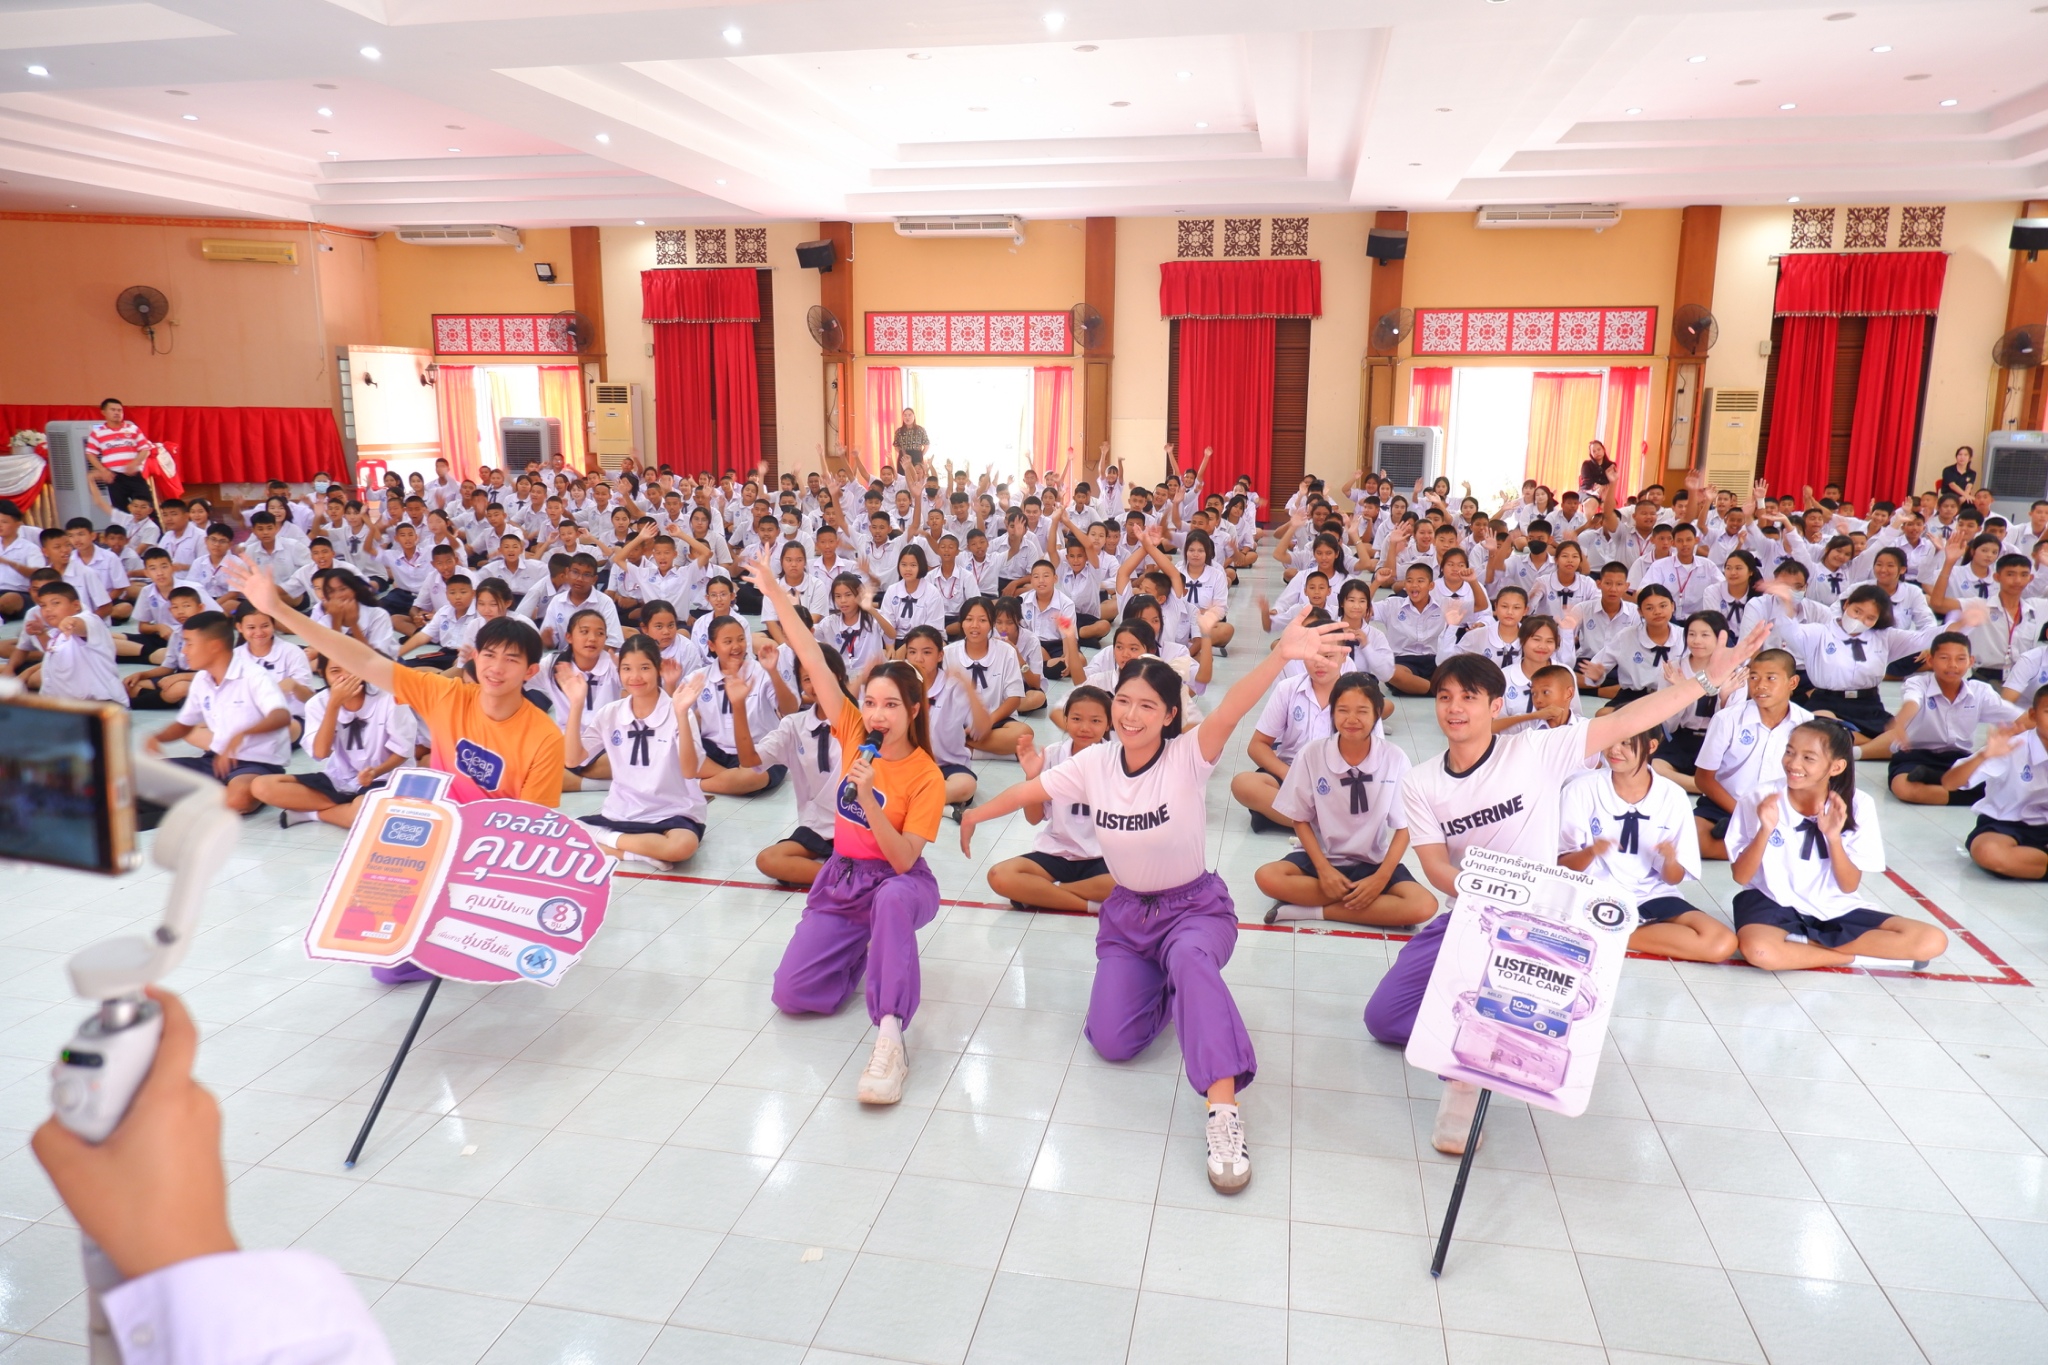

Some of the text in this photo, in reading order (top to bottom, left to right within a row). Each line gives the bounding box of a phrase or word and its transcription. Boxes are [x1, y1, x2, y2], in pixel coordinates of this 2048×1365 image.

[461, 748, 495, 771] Clean
[461, 760, 491, 782] lear
[484, 811, 570, 838] เจลส้ม
[1096, 803, 1170, 831] LISTERINE
[1441, 794, 1524, 837] LISTERINE
[388, 830, 417, 842] Clear
[391, 821, 424, 833] Clean
[370, 851, 426, 871] foaming
[462, 836, 618, 886] คุมมัน
[1465, 860, 1537, 883] ปากสะอาดขึ้น
[1469, 847, 1594, 886] บ้วนทุกครั้งหลังแปรงฟัน
[1470, 878, 1517, 900] 5 เท่า
[553, 904, 568, 922] 8
[1601, 909, 1614, 919] #1
[1531, 927, 1581, 945] ZERO ALCOHOL
[1494, 955, 1576, 989] LISTERINE
[1498, 969, 1533, 985] TOTAL
[1536, 980, 1569, 996] CARE
[1487, 991, 1503, 999] MILD
[1548, 1009, 1568, 1020] TASTE
